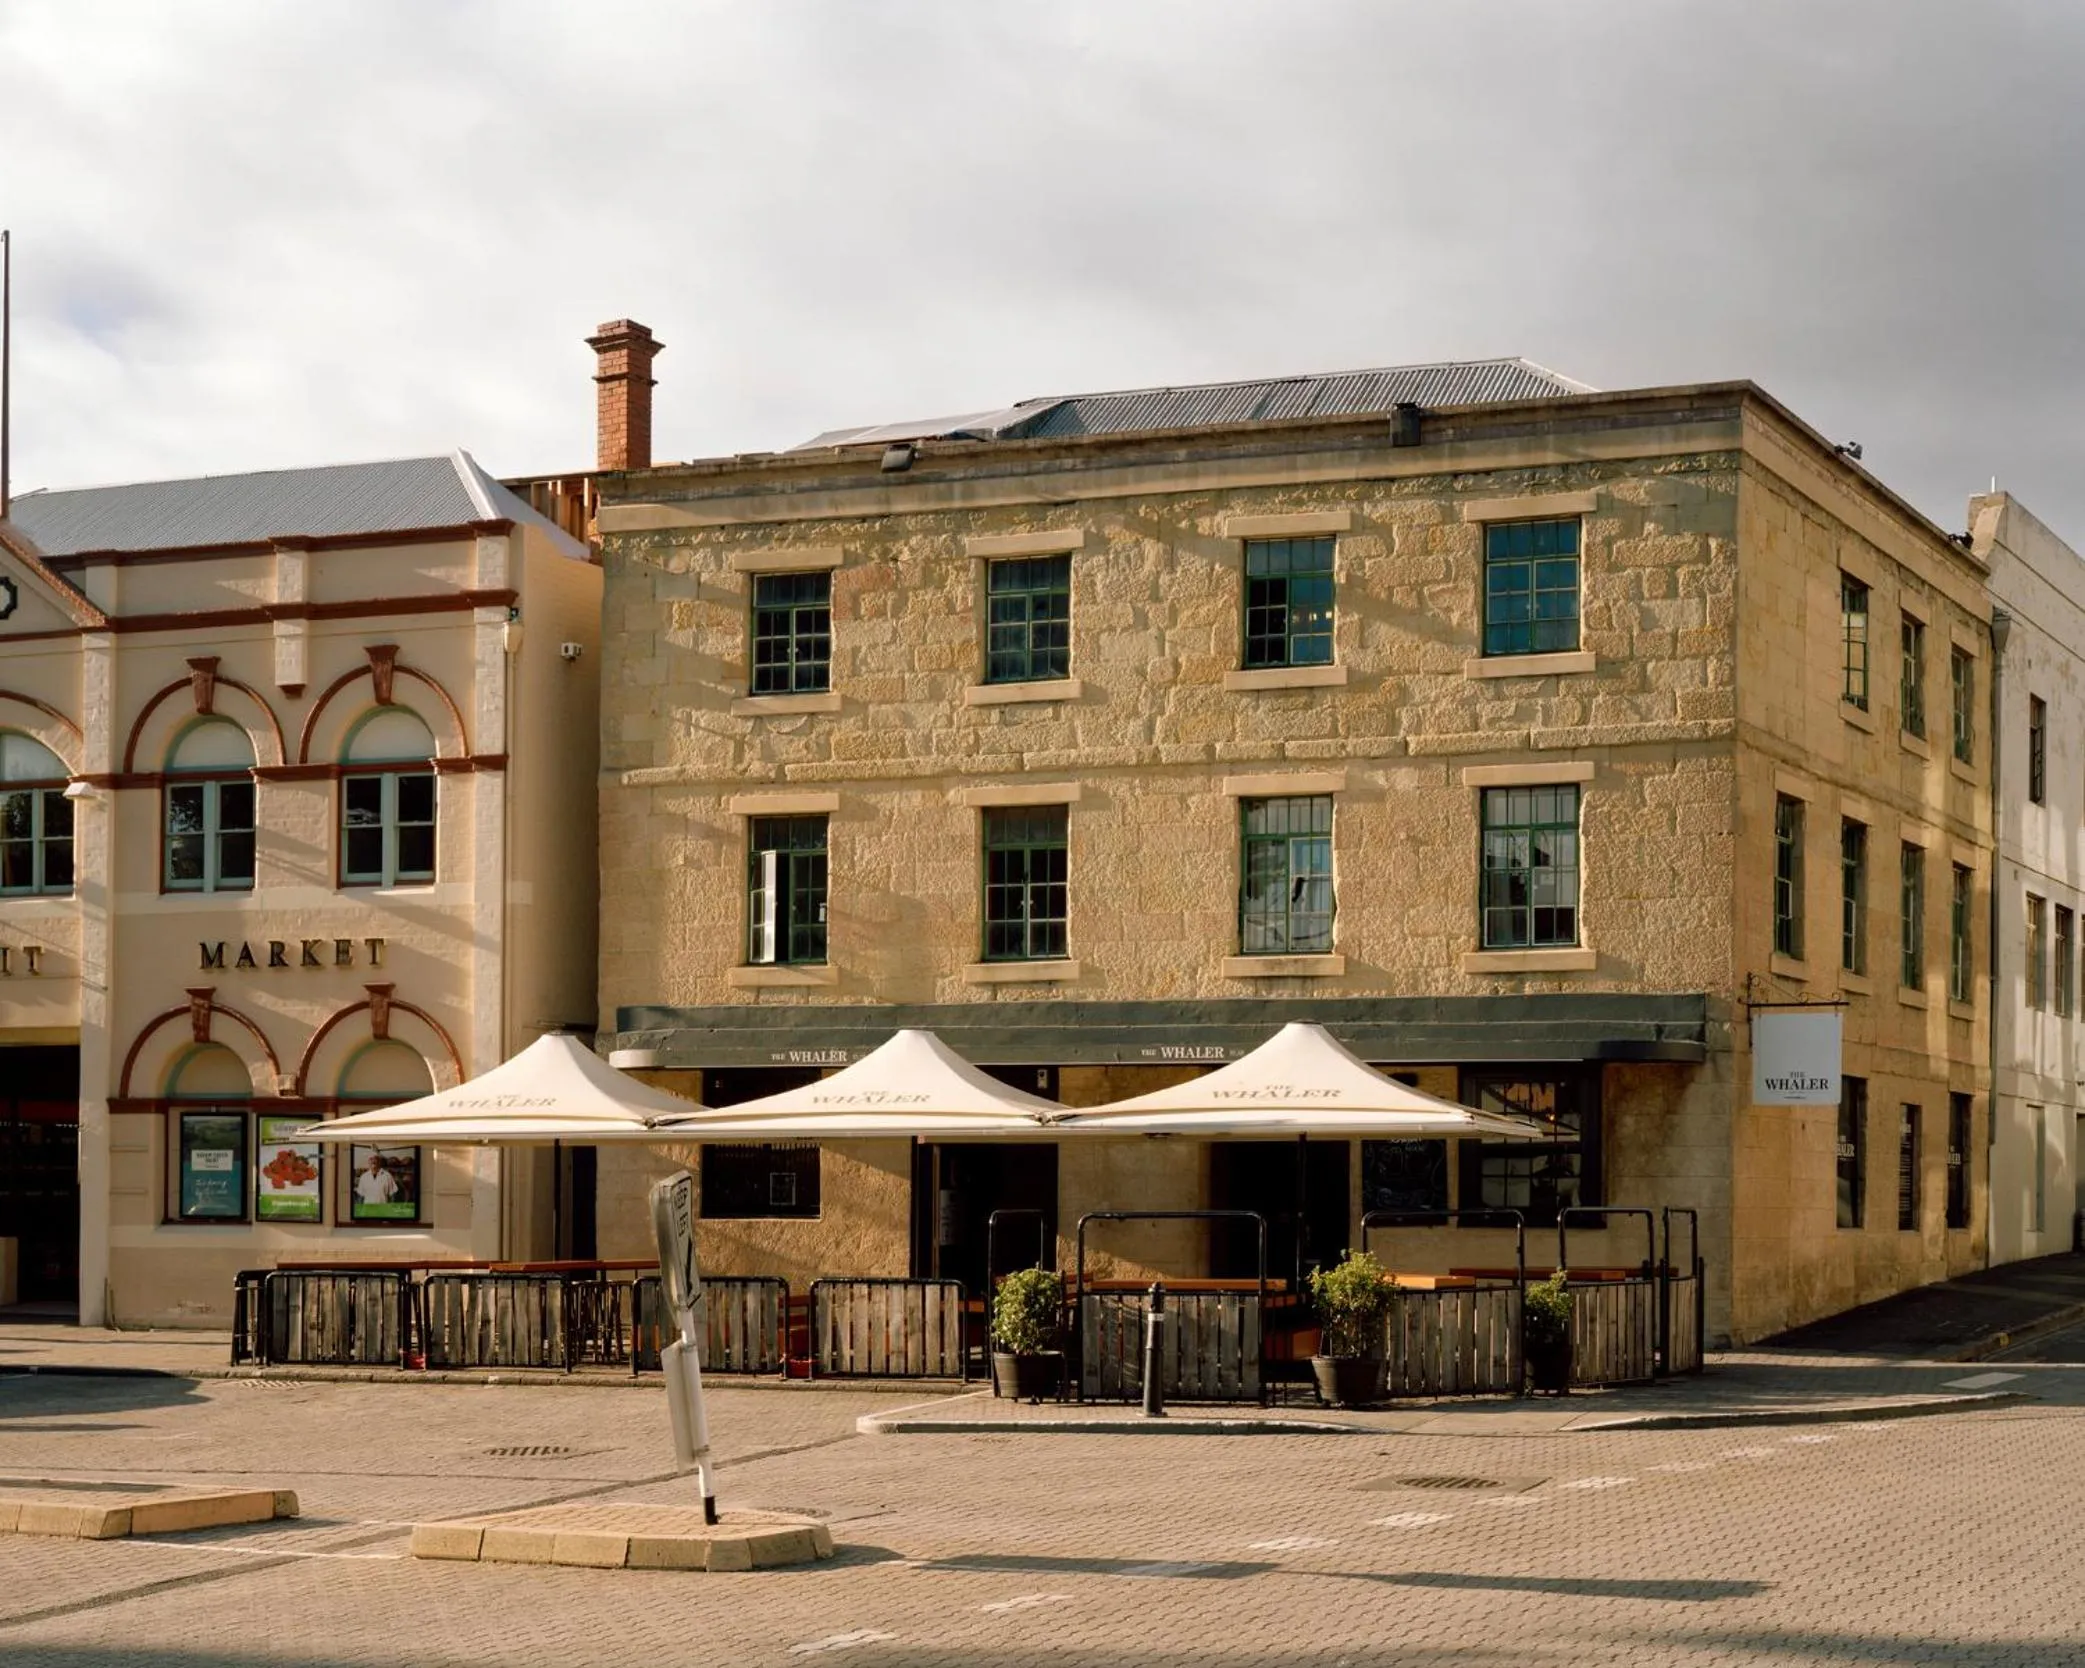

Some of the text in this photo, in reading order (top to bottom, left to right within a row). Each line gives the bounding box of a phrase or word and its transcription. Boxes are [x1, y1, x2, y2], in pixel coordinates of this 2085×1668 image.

[200, 938, 385, 970] MARKET
[789, 1050, 848, 1063] WHALER
[1161, 1046, 1225, 1059] WHALER
[1765, 1078, 1829, 1091] WHALER
[813, 1095, 931, 1104] WHALER
[1212, 1089, 1342, 1099] WHALER
[449, 1098, 557, 1108] WHALER
